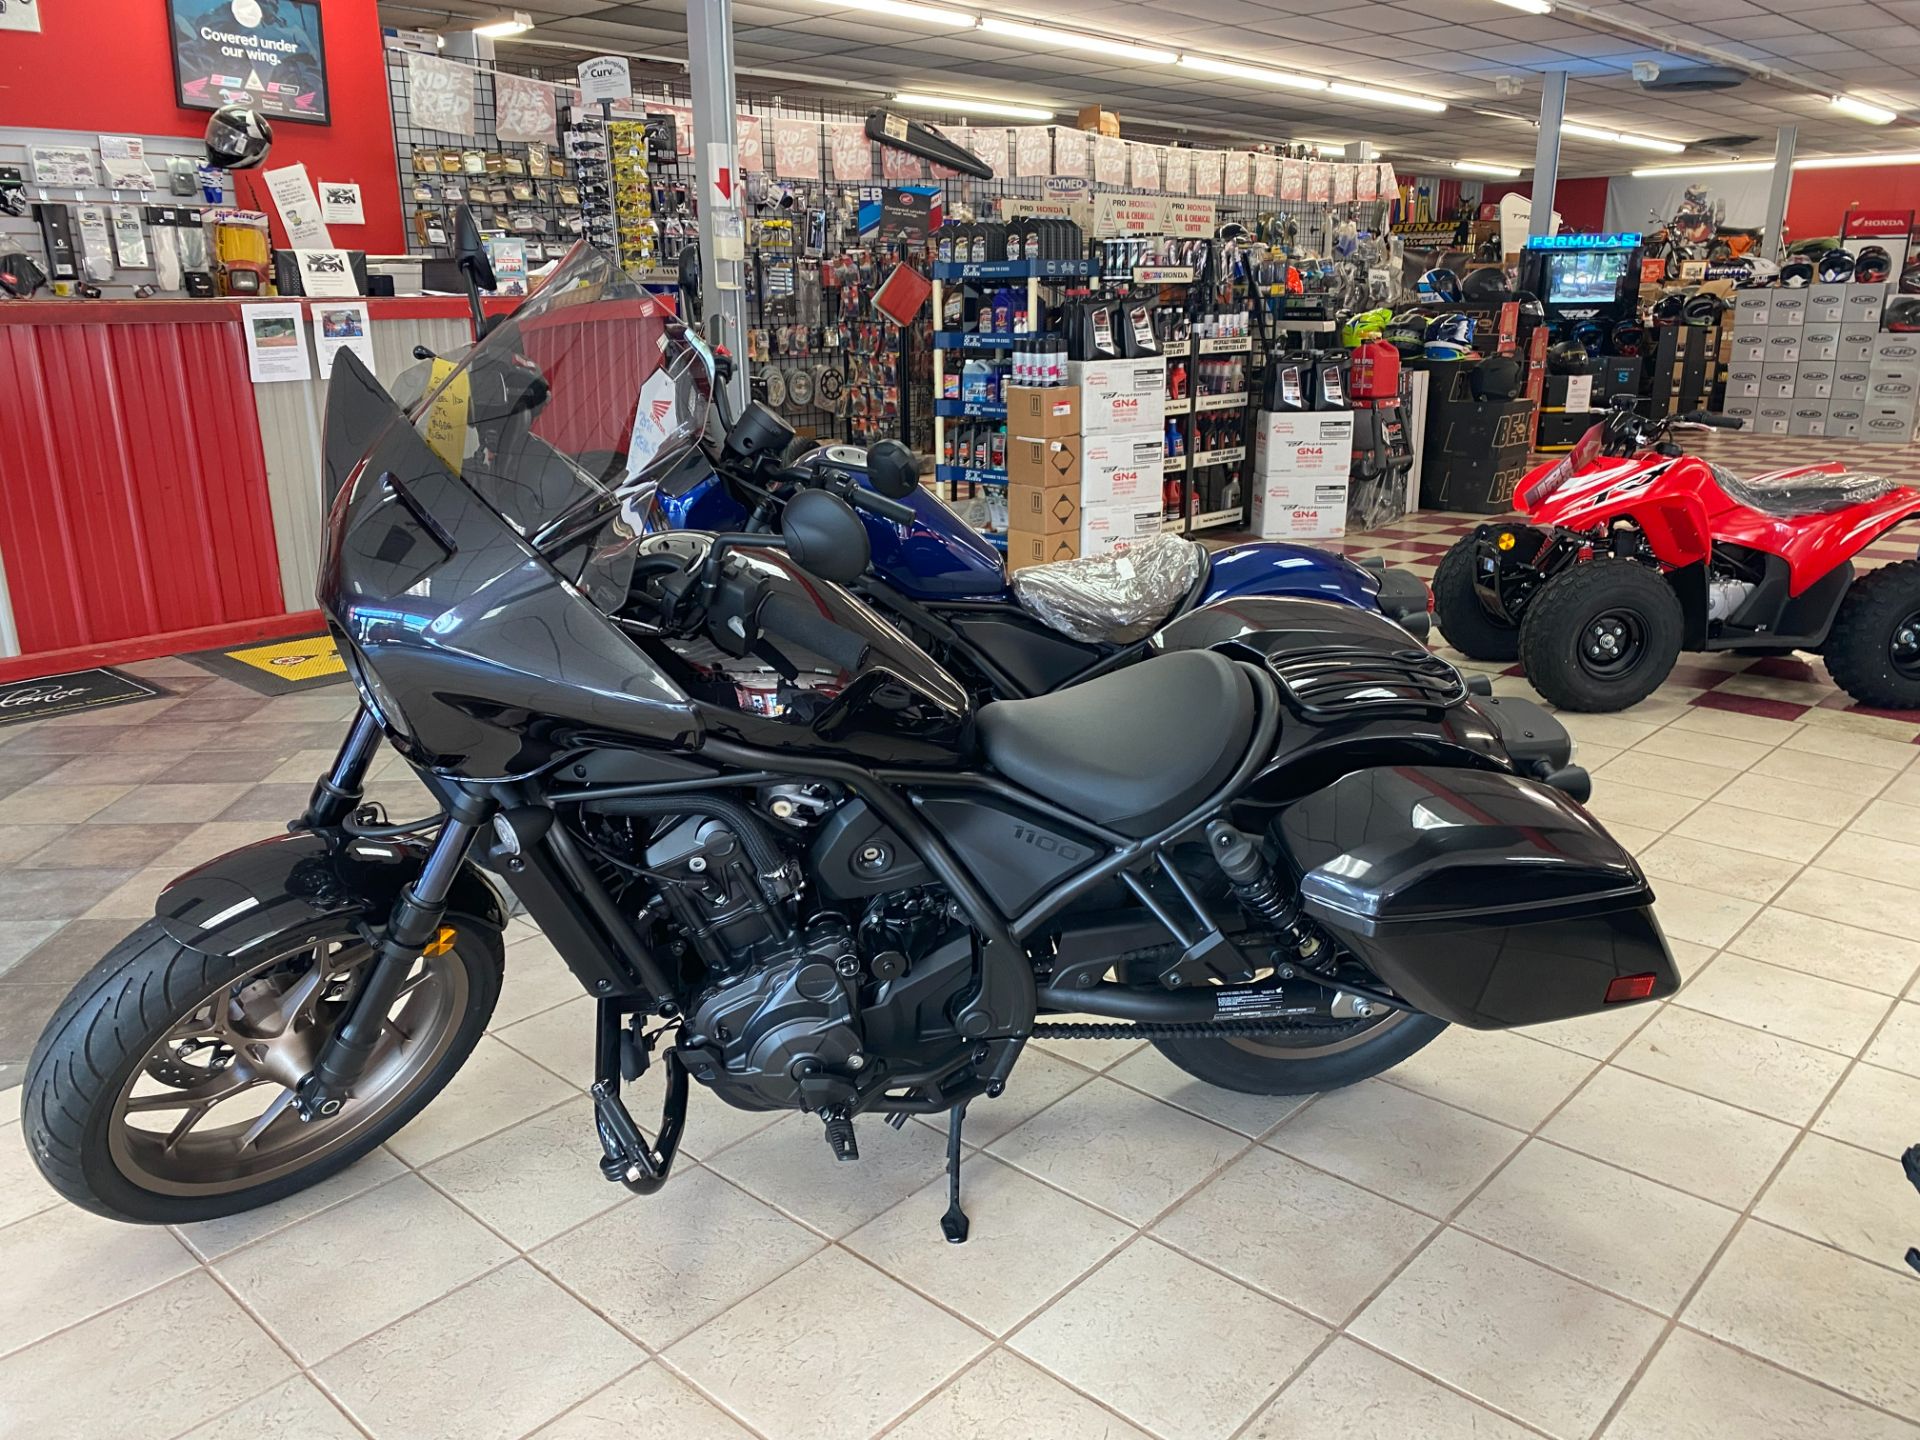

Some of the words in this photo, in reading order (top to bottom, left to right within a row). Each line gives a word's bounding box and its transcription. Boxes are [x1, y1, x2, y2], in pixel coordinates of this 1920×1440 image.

[201, 27, 257, 46] Covered
[261, 37, 298, 53] under
[221, 46, 244, 58] our
[247, 50, 281, 66] wing.
[590, 68, 613, 78] Curv
[414, 69, 463, 90] RIDE
[422, 91, 470, 116] RED
[778, 128, 808, 146] RIDE
[781, 147, 815, 168] RED
[1046, 179, 1084, 190] CLYMER
[1128, 200, 1157, 209] HONDA
[1187, 204, 1212, 212] HONDA
[1116, 211, 1125, 219] OIL
[1132, 212, 1154, 220] CHEMICAL
[1175, 214, 1184, 222] OIL
[1190, 214, 1210, 222] CHEMICAL
[116, 220, 139, 230] Lens
[1126, 222, 1144, 230] CENTER
[1185, 224, 1201, 232] CENTER
[1392, 222, 1460, 233] DUNLOP
[1533, 235, 1619, 246] FORMULA
[1621, 234, 1636, 246] S
[1112, 399, 1138, 408] GN4
[1297, 447, 1323, 455] GN4
[1112, 472, 1138, 480] GN4
[1842, 479, 1894, 501] HONDA
[1014, 824, 1081, 860] 1100
